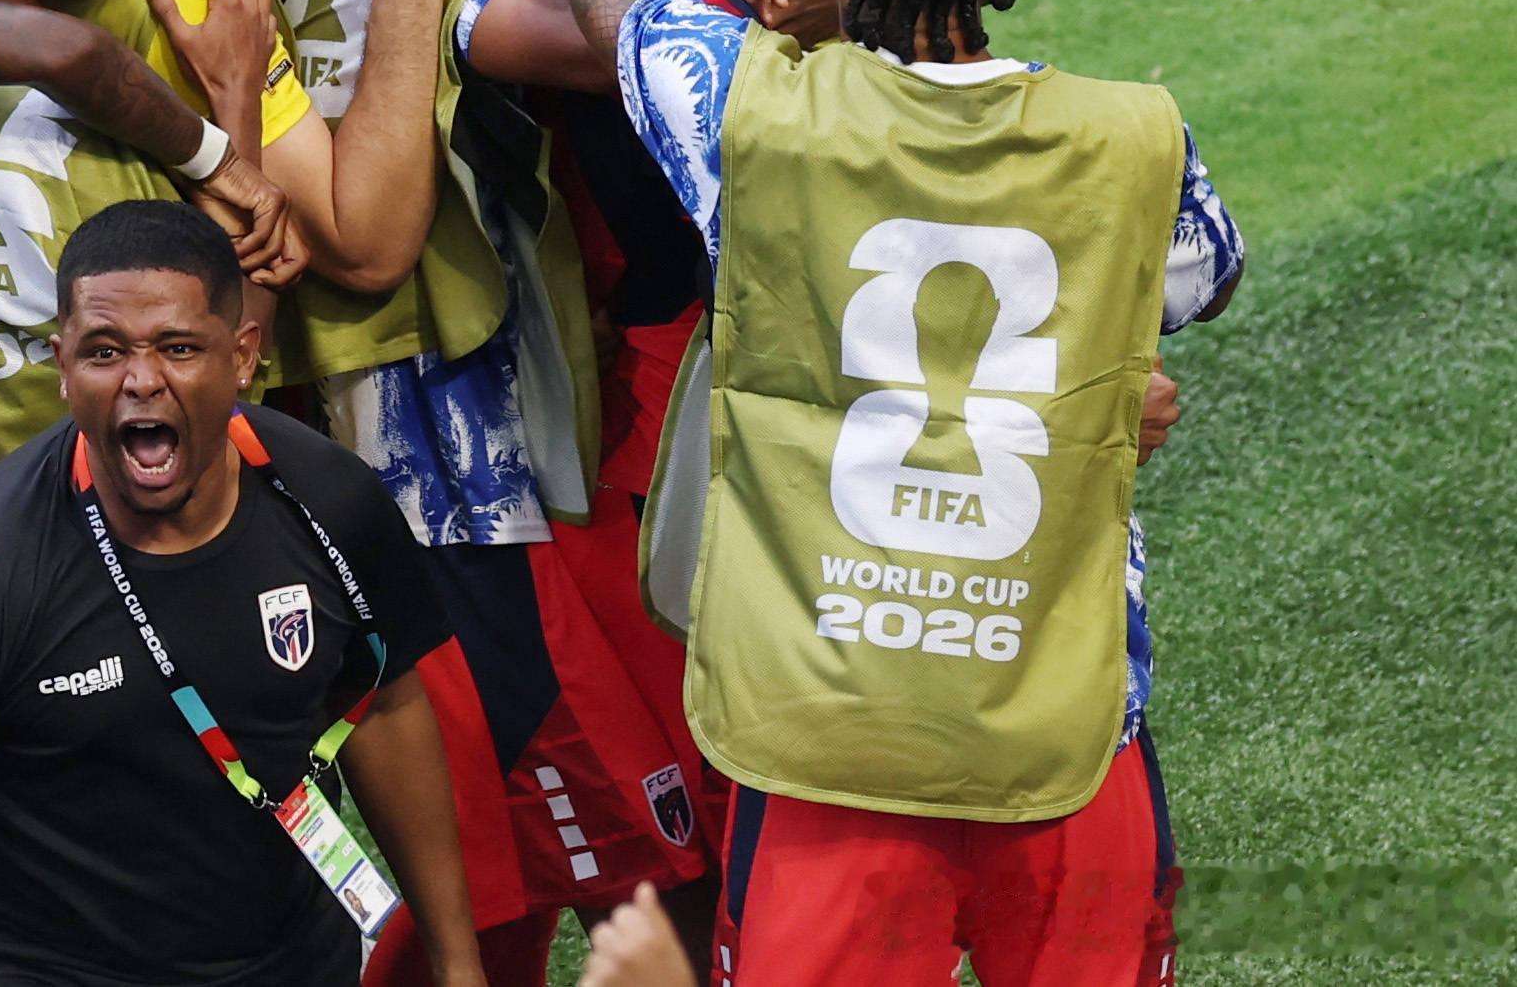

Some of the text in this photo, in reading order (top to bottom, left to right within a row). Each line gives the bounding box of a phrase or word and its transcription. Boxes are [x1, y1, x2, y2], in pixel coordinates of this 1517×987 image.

[301, 56, 343, 88] IFA
[890, 483, 987, 528] FIFA
[85, 504, 175, 677] FIFA WORLD CUP 2026
[328, 545, 359, 597] WORLD
[821, 554, 1030, 608] WORLD CUP
[264, 590, 304, 610] FCF
[352, 592, 373, 620] FIFA
[815, 593, 1023, 662] 2026
[38, 655, 124, 696] capelli
[79, 677, 124, 696] SPORT
[646, 766, 678, 794] FCF
